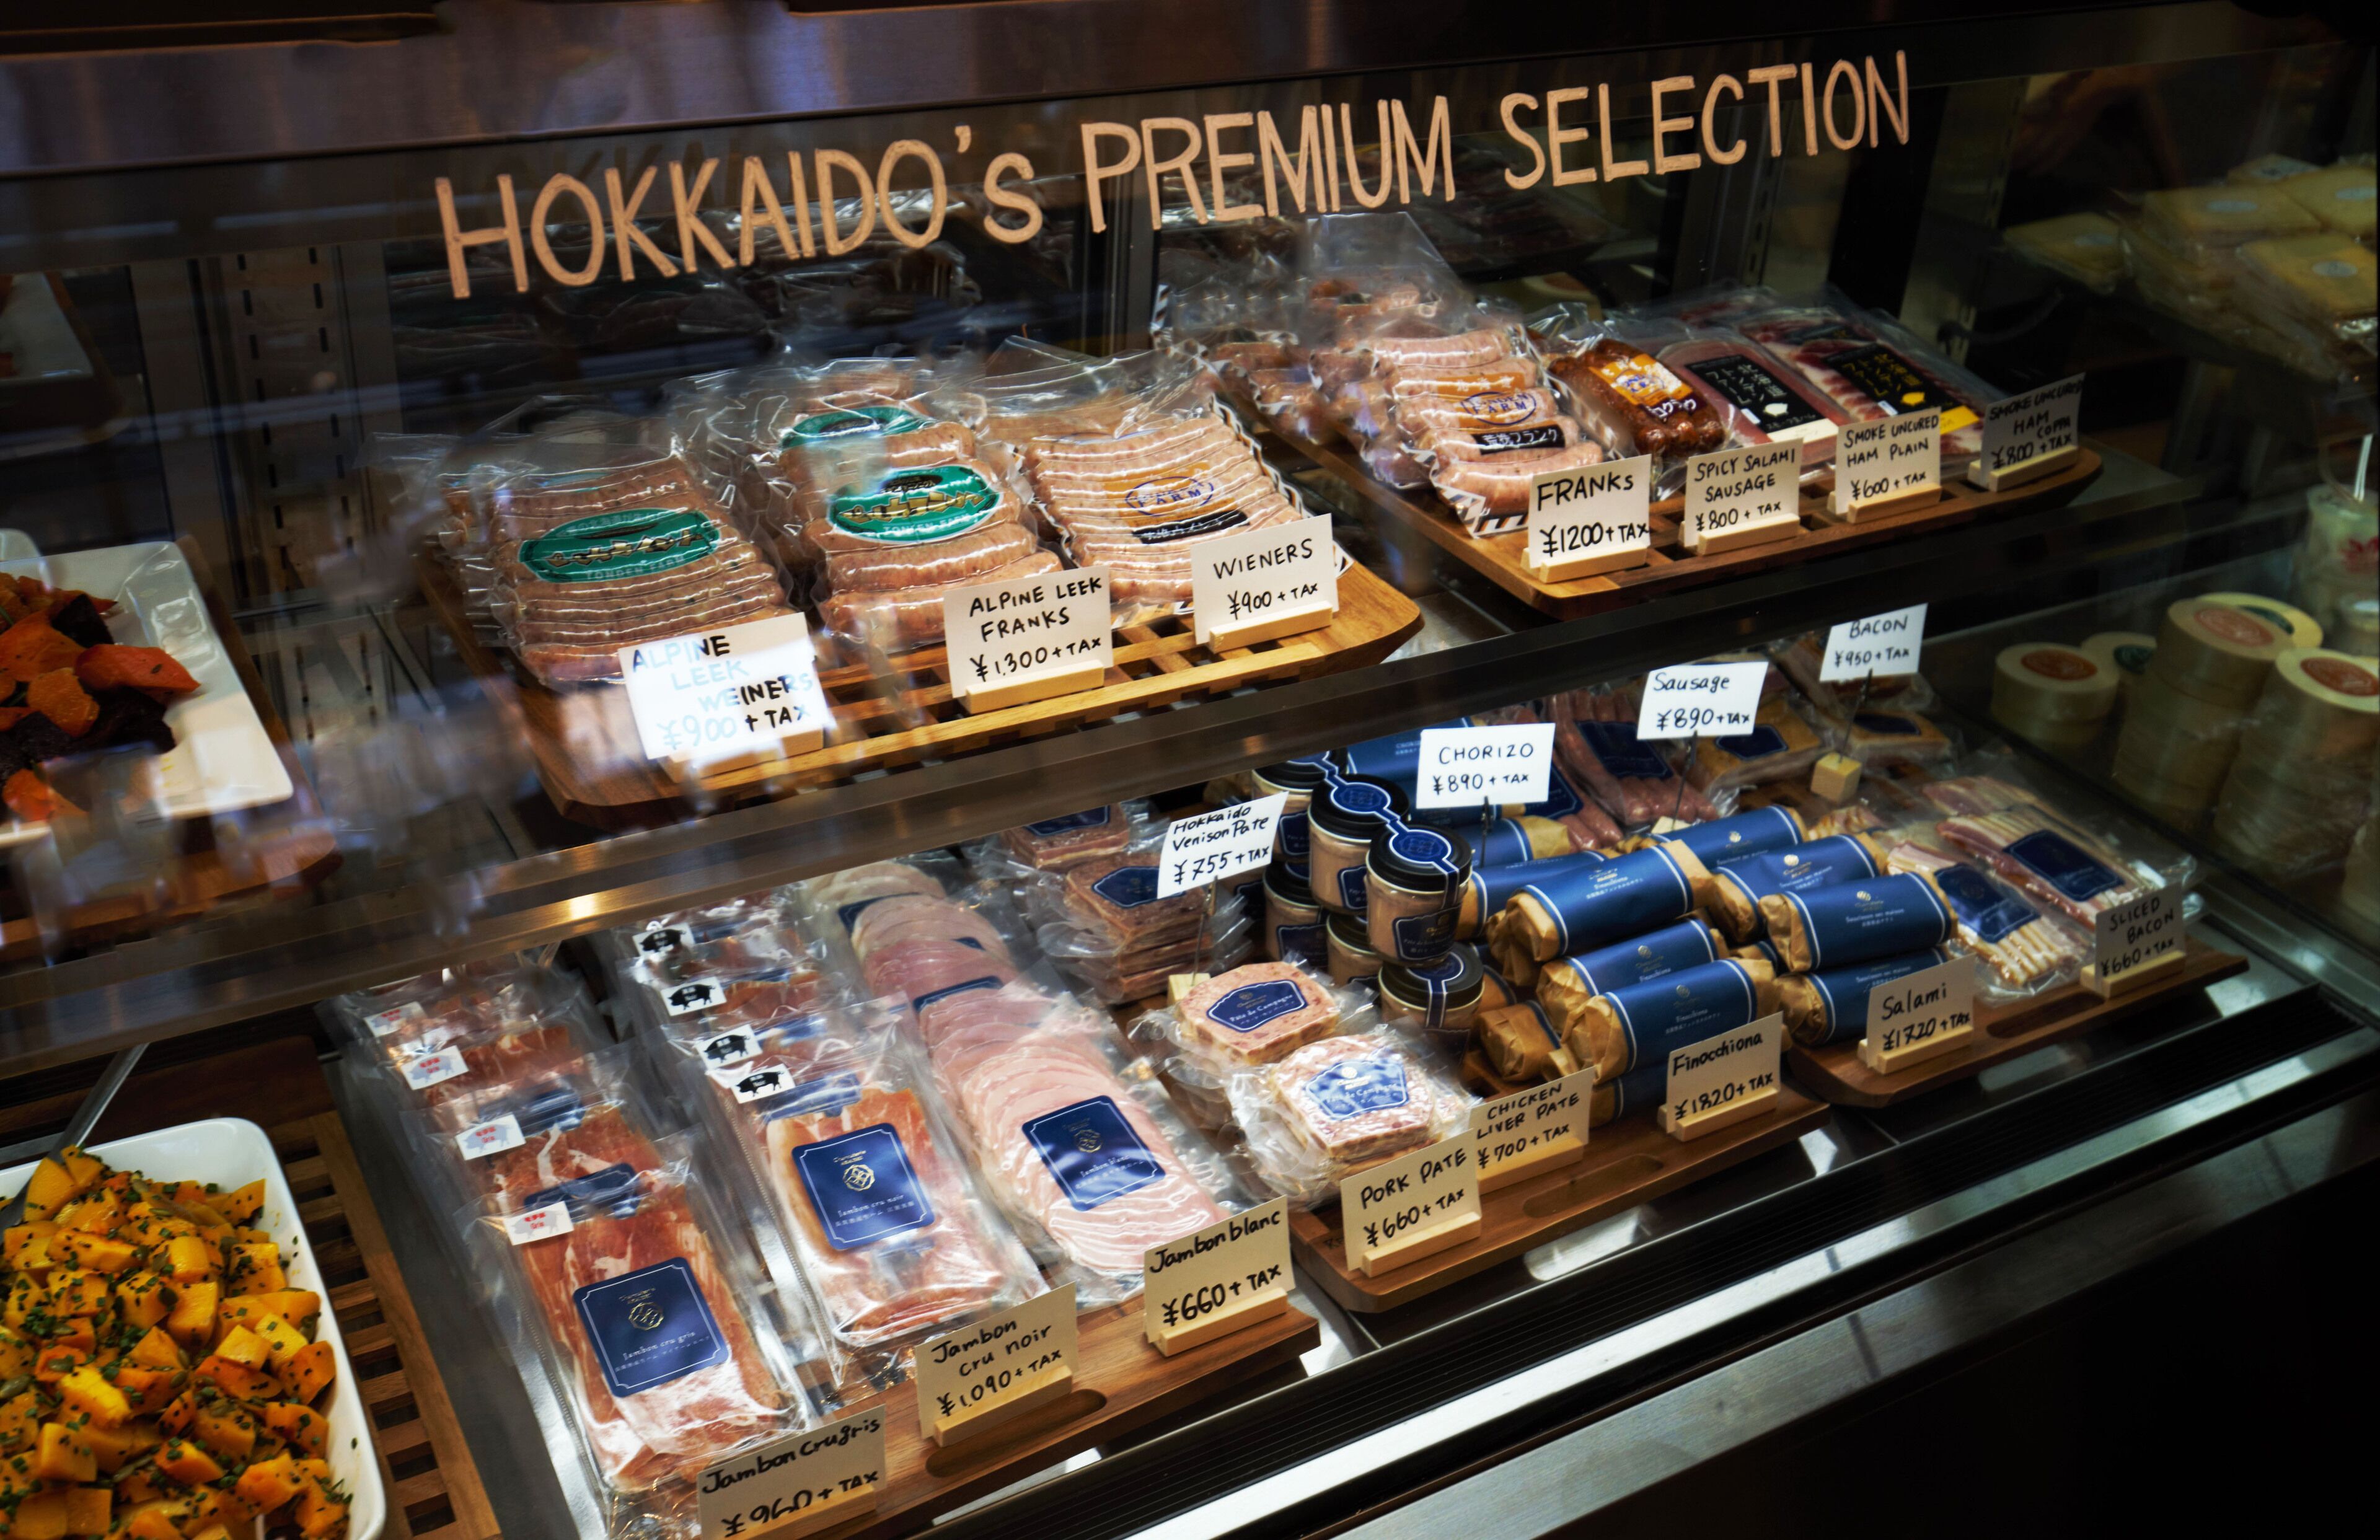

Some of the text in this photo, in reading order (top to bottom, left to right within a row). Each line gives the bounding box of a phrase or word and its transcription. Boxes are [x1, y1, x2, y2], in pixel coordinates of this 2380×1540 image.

[434, 49, 1910, 299] HOKKAIDO's PREMIUM SELECTION
[1989, 395, 2032, 421] SMOKE
[2014, 410, 2049, 435] HAM
[1844, 415, 1939, 449] SMOKE UNCURED
[2037, 415, 2071, 439] COPPA
[1694, 448, 1795, 482] SPICY SALAMI
[1847, 437, 1929, 467] HAM PLAIN
[1537, 472, 1634, 511] FRANKS
[1704, 473, 1776, 503] SAUSAGE
[1851, 477, 1889, 501] ¥600
[1695, 508, 1739, 532] ¥800
[1213, 538, 1313, 579] WIENERS
[969, 576, 1102, 617] ALPINE LEEK
[1227, 589, 1272, 620] ¥900
[980, 605, 1070, 642] FRANKS
[1849, 615, 1908, 639] BACON
[632, 635, 729, 673] ALPINE
[670, 659, 749, 690] LEEK
[697, 672, 814, 713] WEINERS
[1653, 672, 1730, 693] Sausage
[656, 714, 737, 750] ¥900
[1438, 742, 1534, 765] CHORIZO
[1432, 773, 1483, 796] ¥890
[1173, 805, 1252, 835] Hokkaido
[2109, 896, 2161, 931] SLICED
[2127, 908, 2174, 944] BACON
[1882, 982, 1947, 1021] Salami
[1672, 1032, 1763, 1077] Finocchiona
[1476, 1093, 1580, 1140] LIVER PATE
[1487, 1082, 1562, 1120] CHICKEN
[1477, 1137, 1527, 1169] ¥700
[1360, 1148, 1468, 1210] PORK PATE
[1149, 1210, 1280, 1274] Jambon blanc
[1363, 1206, 1420, 1247] ¥660
[1161, 1282, 1226, 1327] ¥660
[930, 1319, 1017, 1363] Jambon
[959, 1324, 1052, 1377] cru noir
[702, 1450, 796, 1494] Jambon
